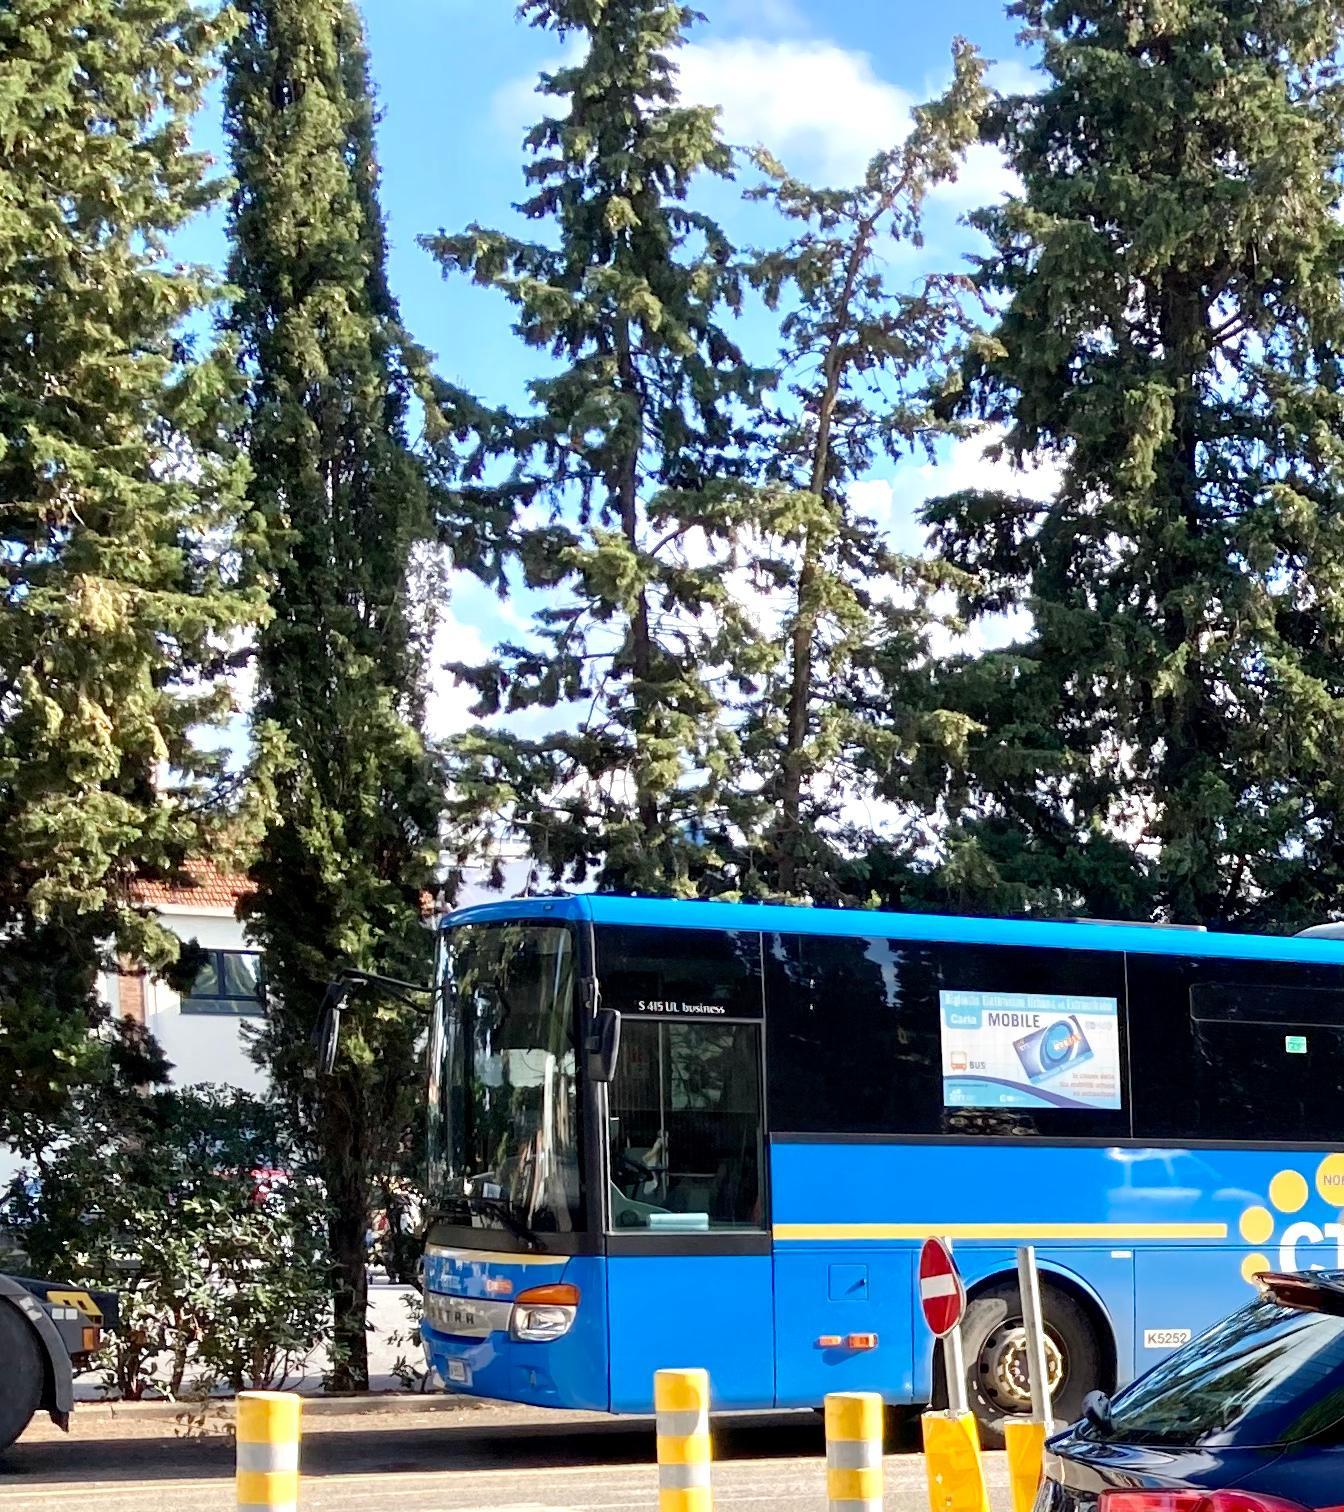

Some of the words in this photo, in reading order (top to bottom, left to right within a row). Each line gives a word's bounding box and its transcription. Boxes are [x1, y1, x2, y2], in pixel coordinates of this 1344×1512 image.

[638, 1001, 646, 1011] S
[647, 1001, 664, 1012] 415
[665, 1001, 680, 1013] UL
[682, 1003, 726, 1014] business
[988, 1012, 1041, 1028] MOBILE
[969, 1061, 986, 1070] BUS
[1147, 1332, 1188, 1345] K5252
